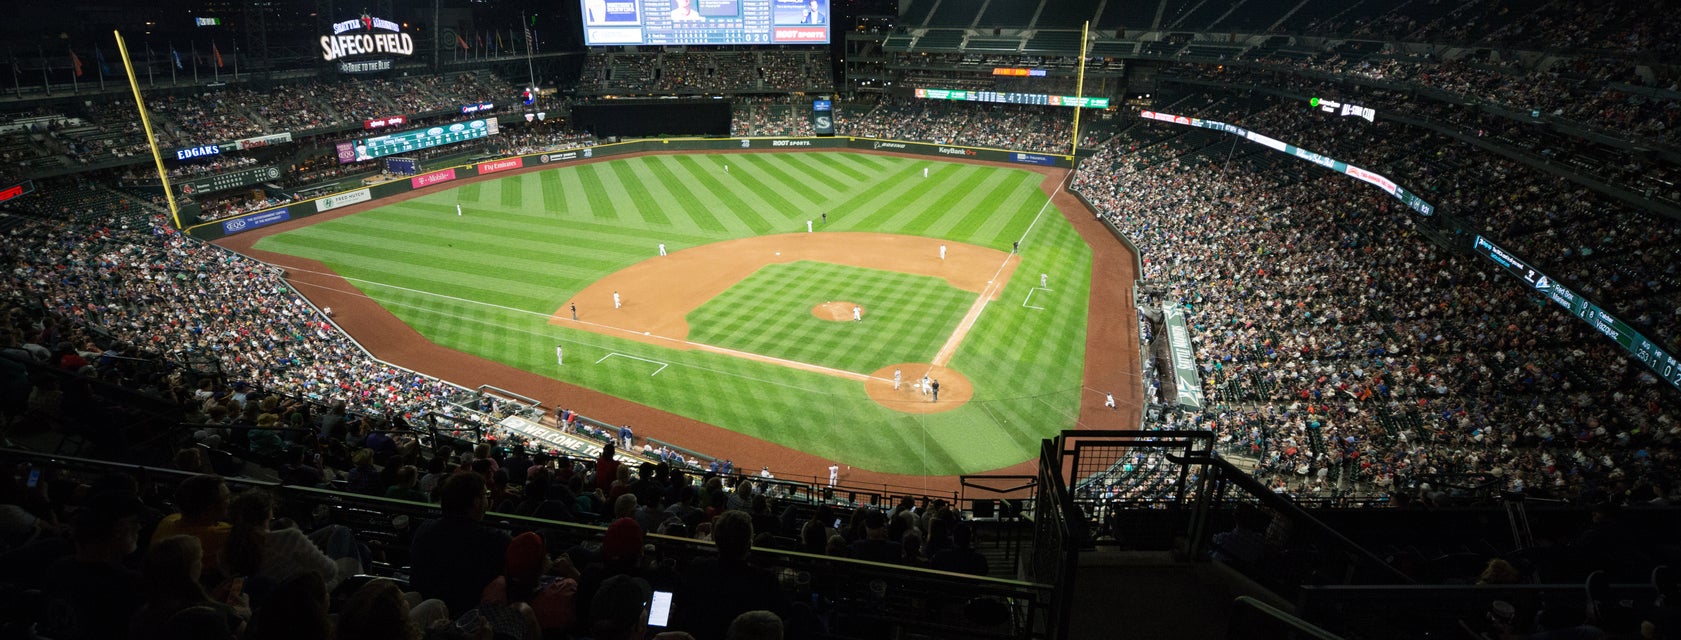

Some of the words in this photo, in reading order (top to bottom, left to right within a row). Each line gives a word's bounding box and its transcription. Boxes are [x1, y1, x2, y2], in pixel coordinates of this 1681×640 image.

[320, 34, 374, 61] SAFECO
[374, 33, 413, 55] FIELD
[939, 146, 965, 155] KeyBank
[495, 160, 516, 169] Emirates
[1556, 284, 1564, 295] Red
[1564, 290, 1574, 300] Sox
[1552, 292, 1571, 309] Mariners
[1664, 366, 1671, 376] 0
[523, 424, 584, 452] WELCOME
[582, 445, 604, 457] TO
